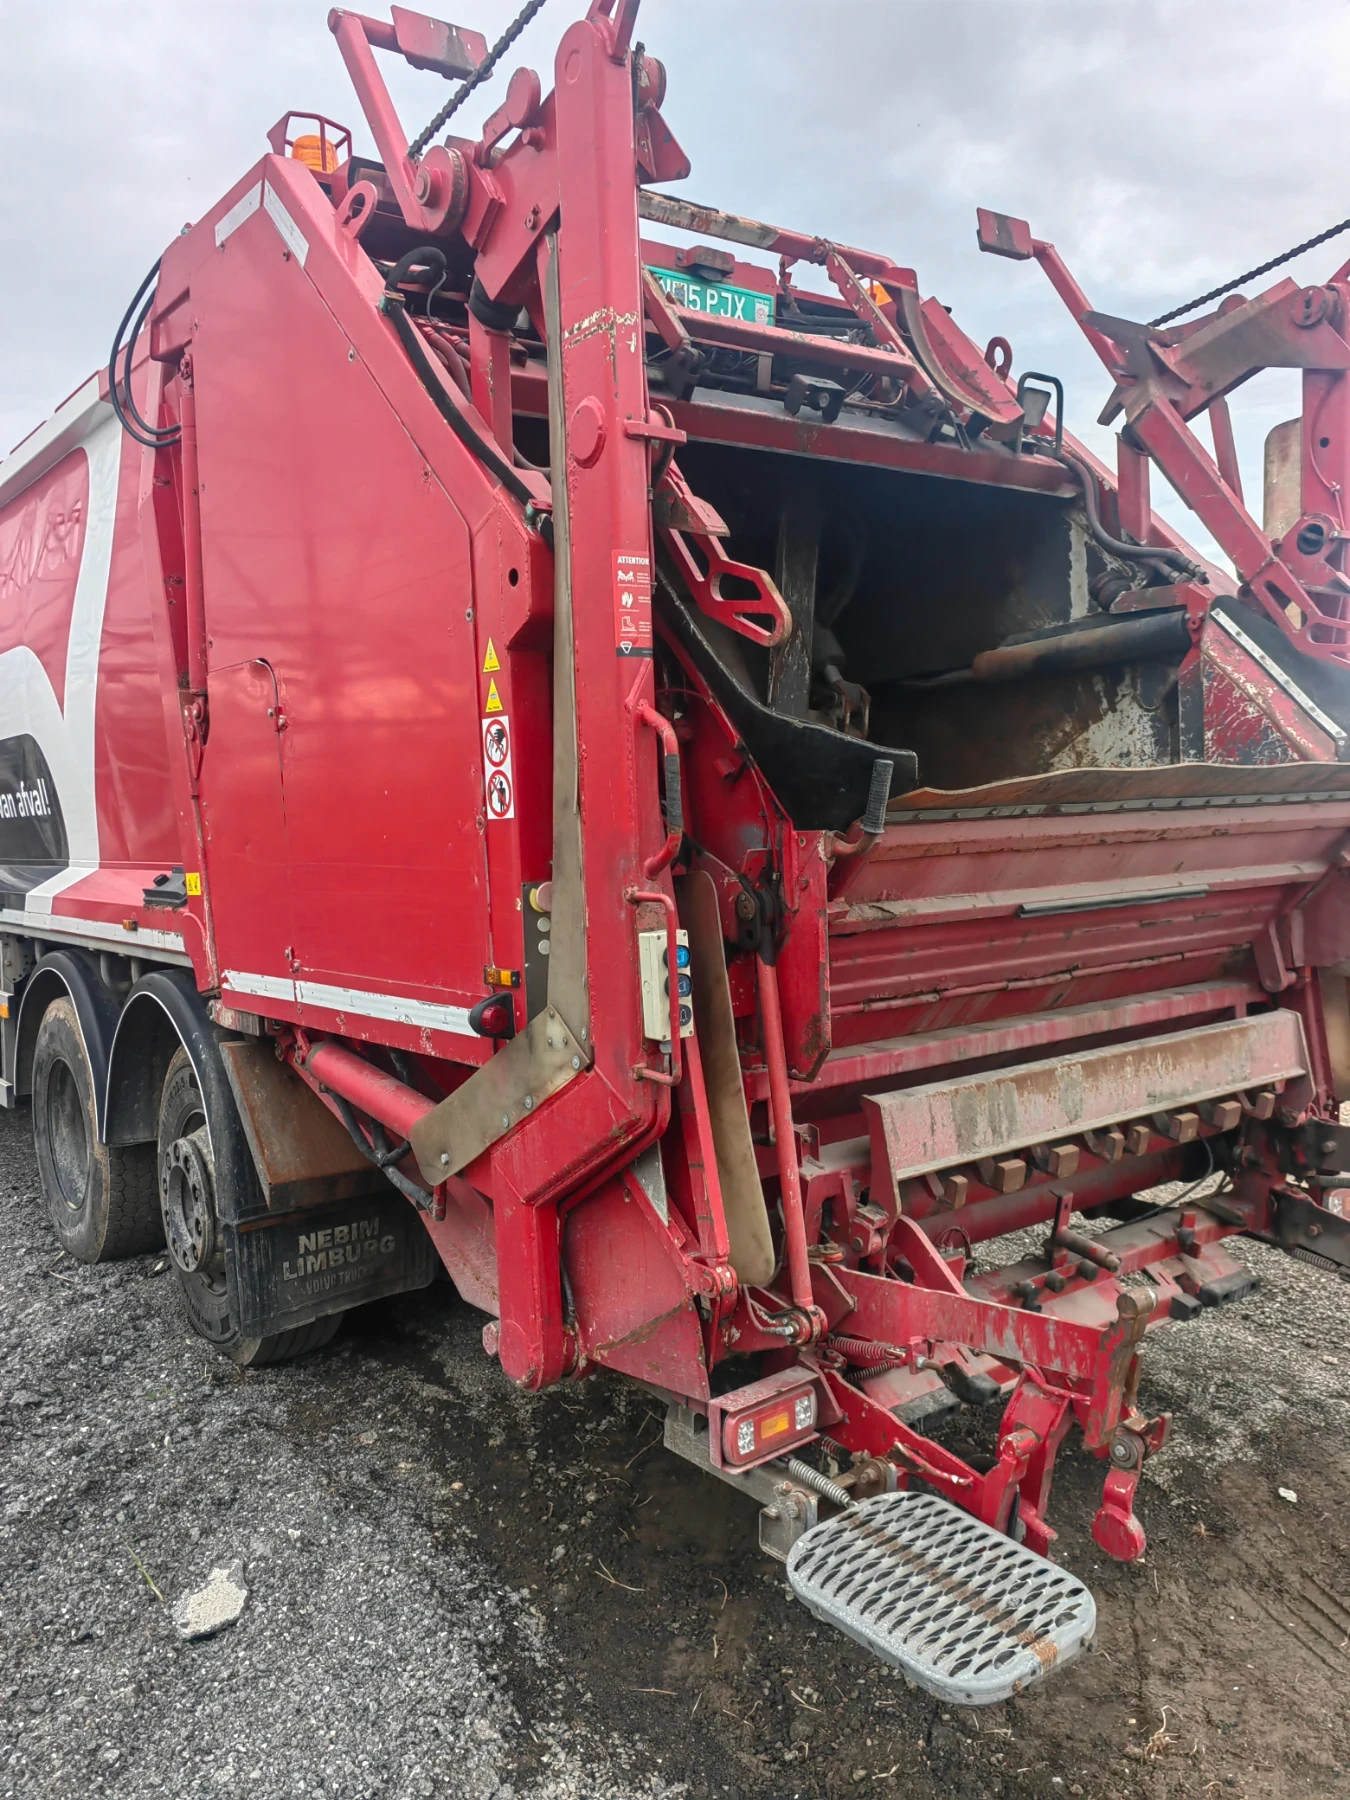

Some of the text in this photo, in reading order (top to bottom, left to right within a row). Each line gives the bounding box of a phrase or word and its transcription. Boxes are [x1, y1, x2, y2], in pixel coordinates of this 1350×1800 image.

[16, 778, 51, 818] afval!
[298, 1218, 379, 1255] NEBIM
[282, 1235, 395, 1281] LIMBURG
